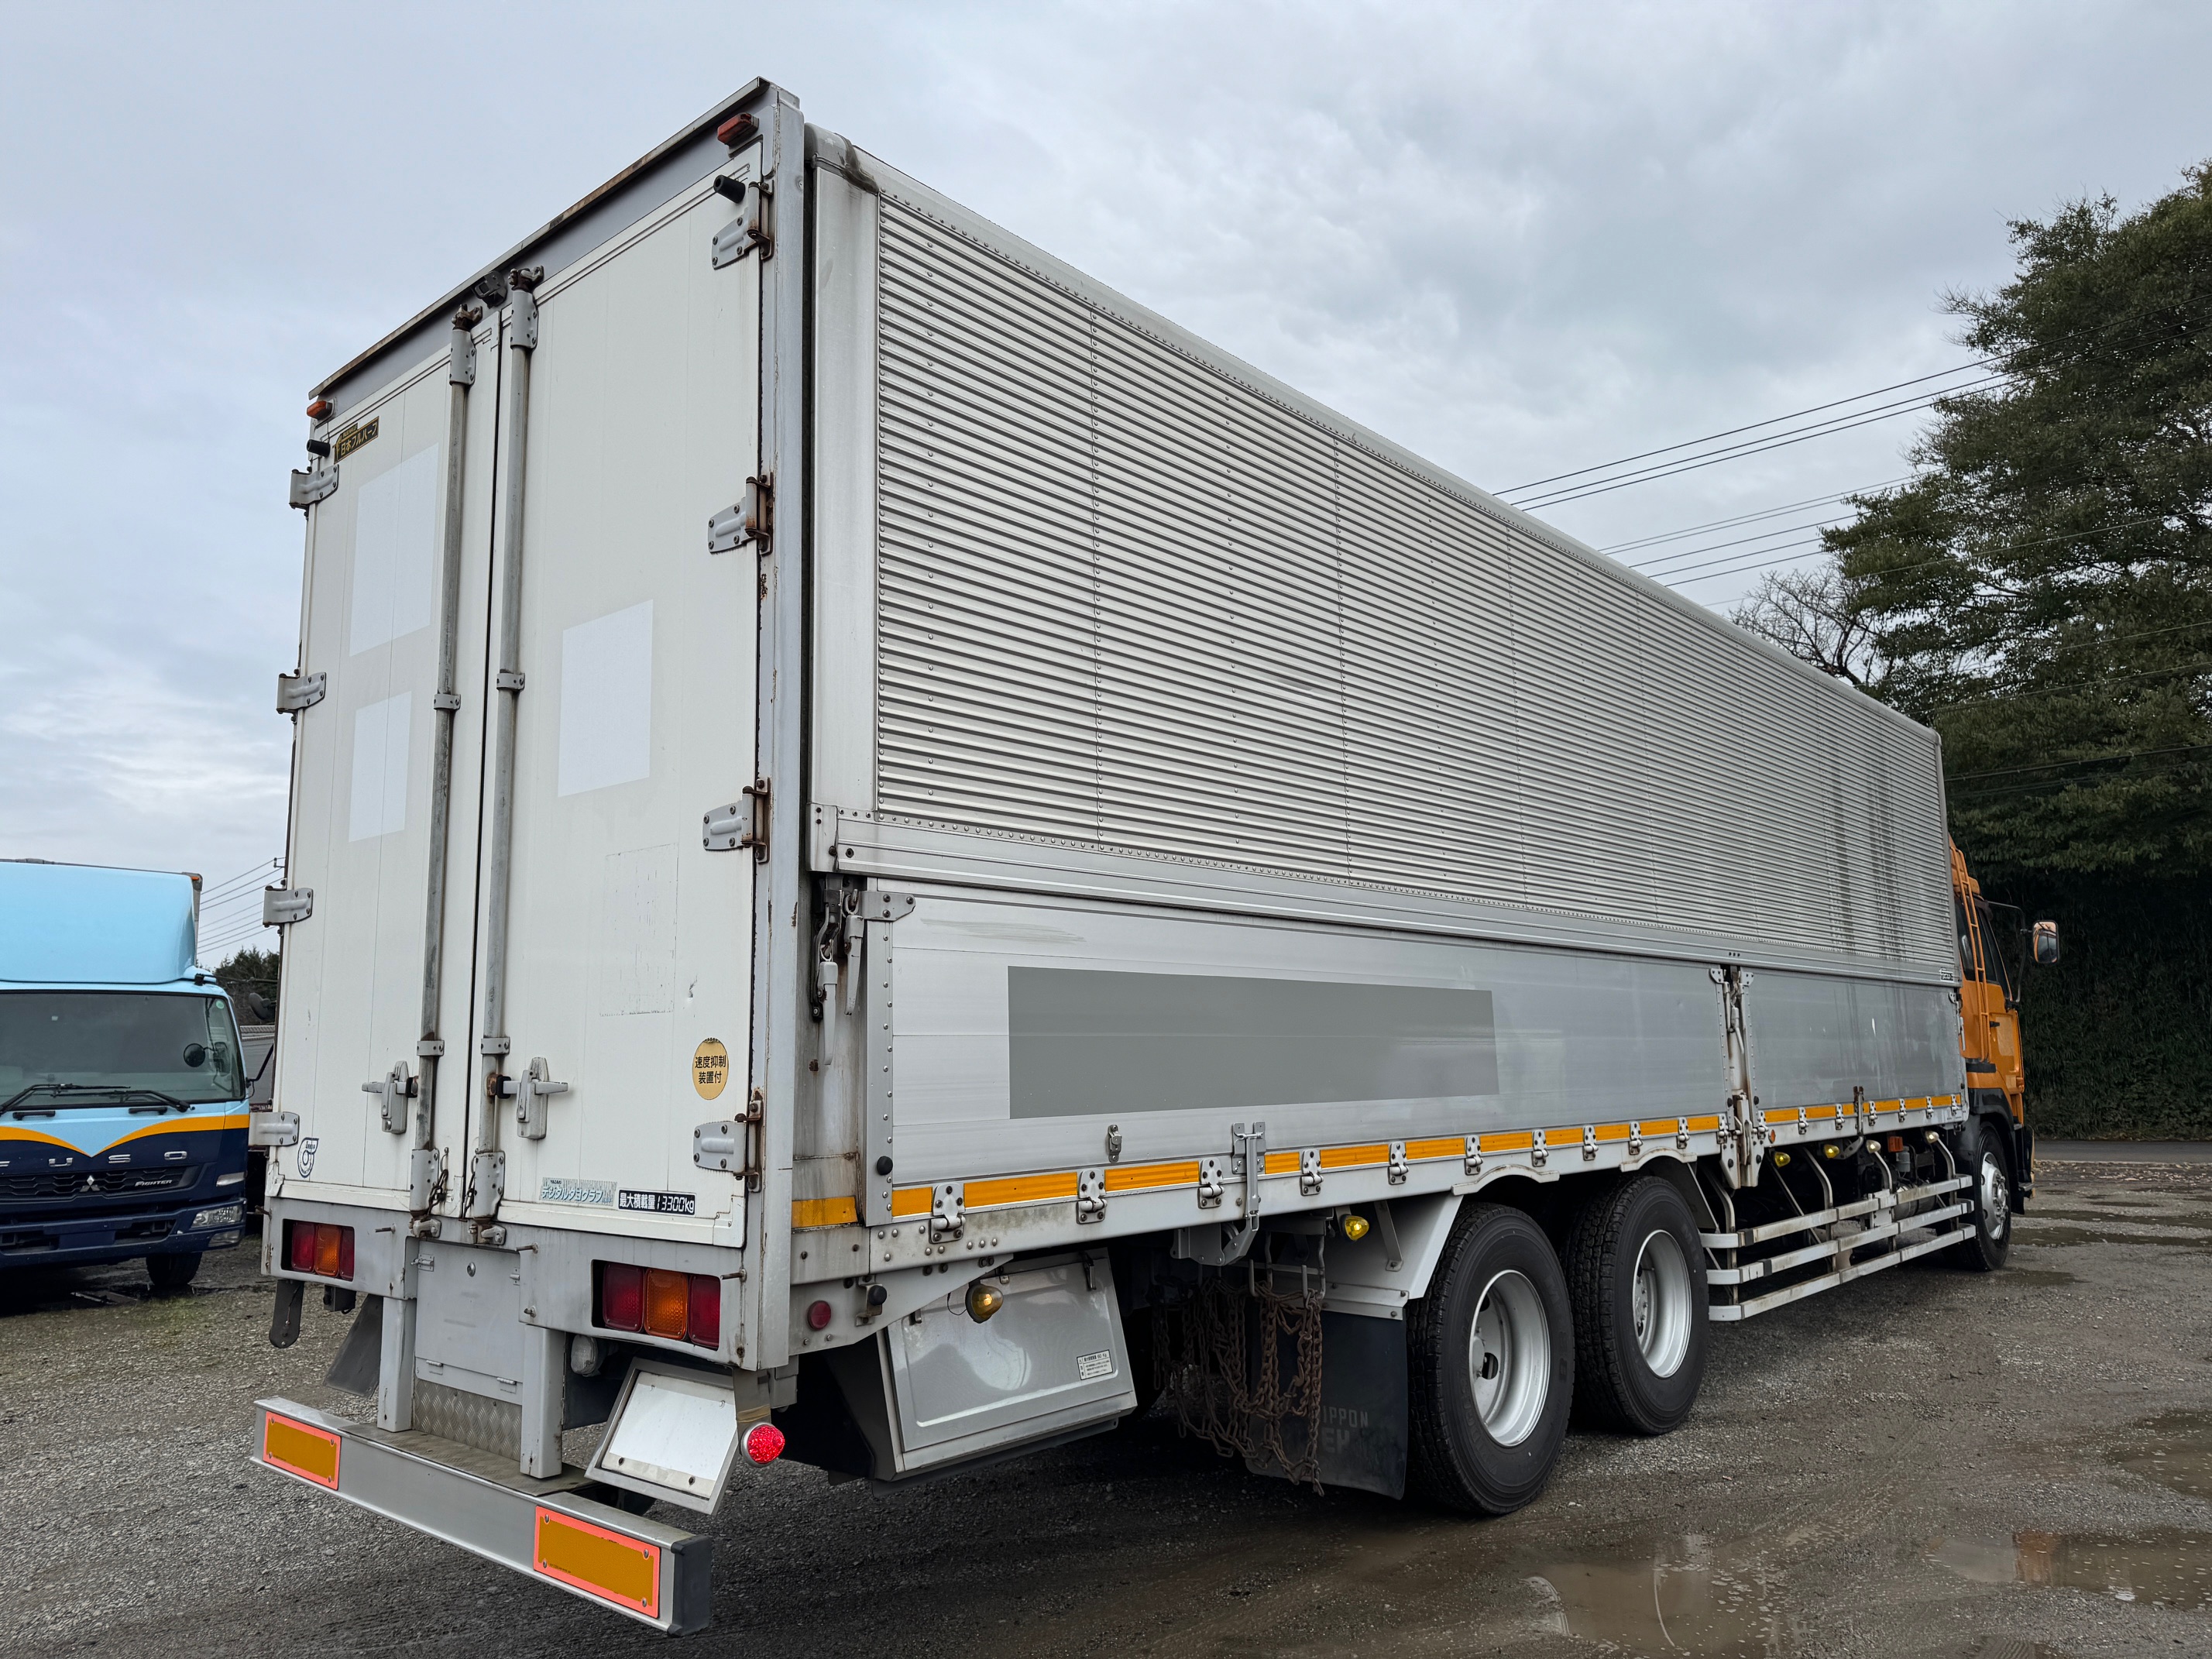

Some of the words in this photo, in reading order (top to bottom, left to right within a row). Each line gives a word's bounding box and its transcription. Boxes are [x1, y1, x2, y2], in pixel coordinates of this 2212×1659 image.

[341, 422, 377, 455] 日本フルハーフ
[695, 1055, 726, 1069] 速度抑制
[698, 1071, 722, 1084] 装置付
[1321, 1405, 1369, 1428] IPPON
